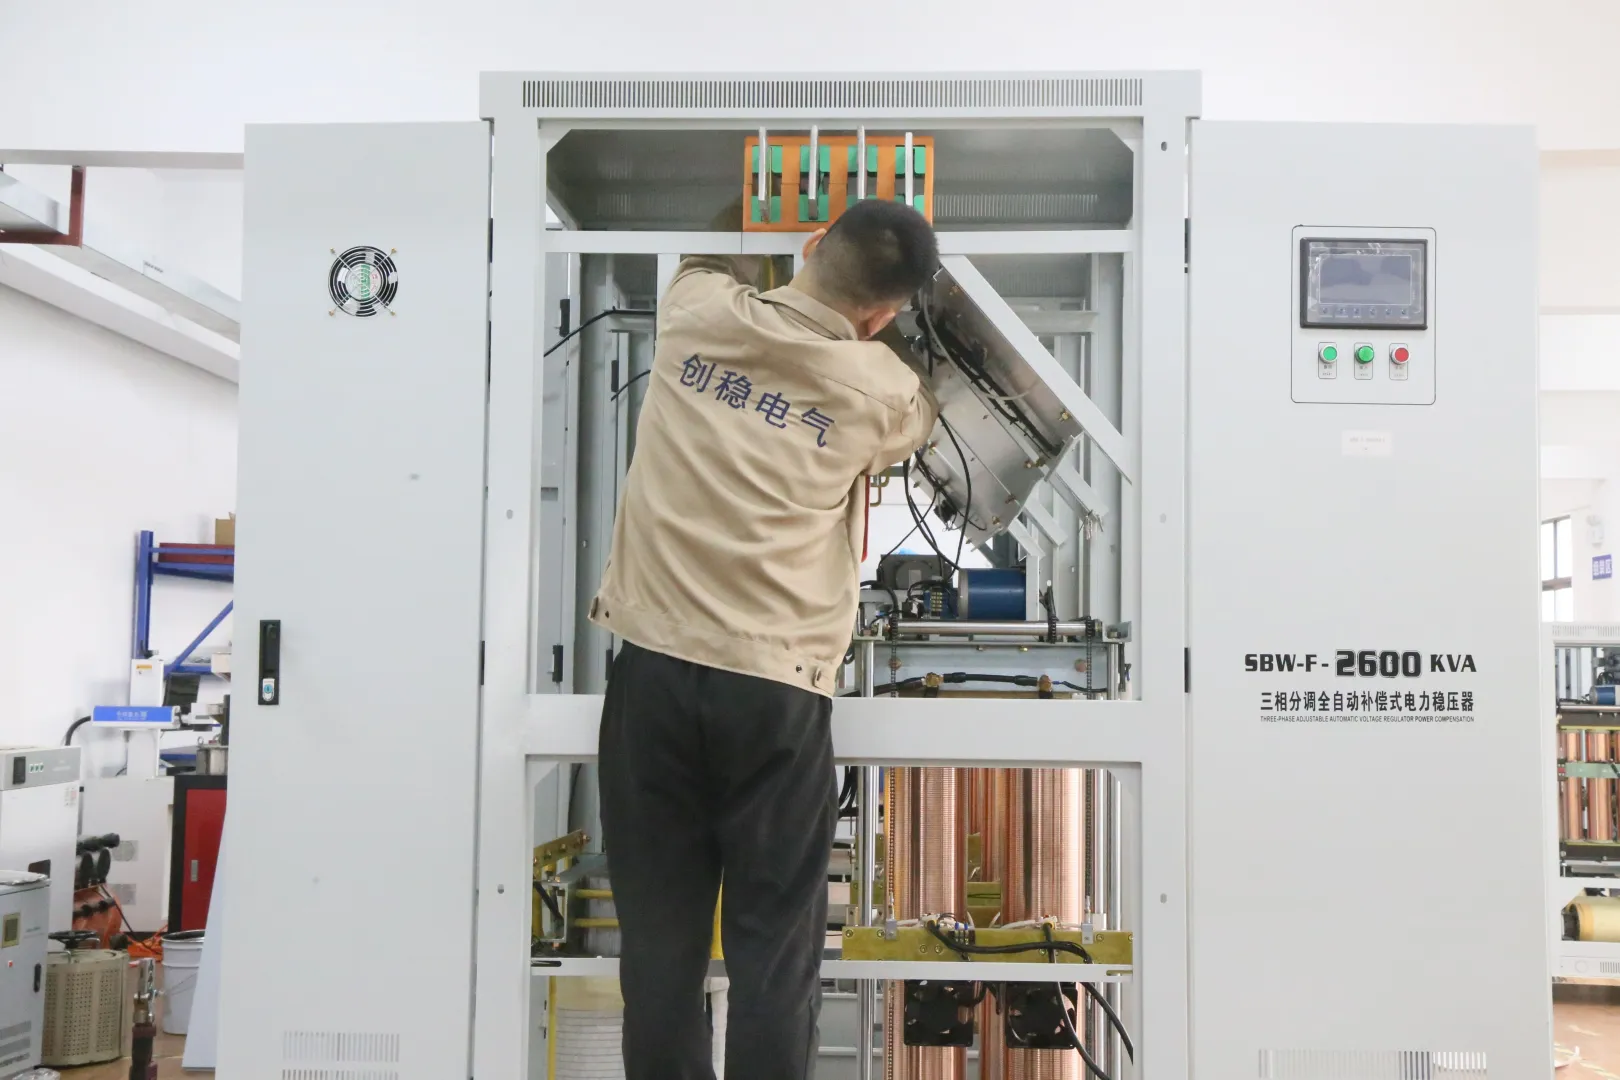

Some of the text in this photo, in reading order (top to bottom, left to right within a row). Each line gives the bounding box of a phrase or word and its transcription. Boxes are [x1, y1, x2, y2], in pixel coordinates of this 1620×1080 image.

[679, 354, 835, 448] 创稳电气
[1430, 654, 1477, 673] KVA
[1260, 691, 1474, 712] 三相分调全自动补偿式电力稳压器
[1260, 715, 1475, 723] THREE-PHASE ADJUSTABLE AUTOMATIC VOLTAGE REGULATOR POWER COMPENSATION
